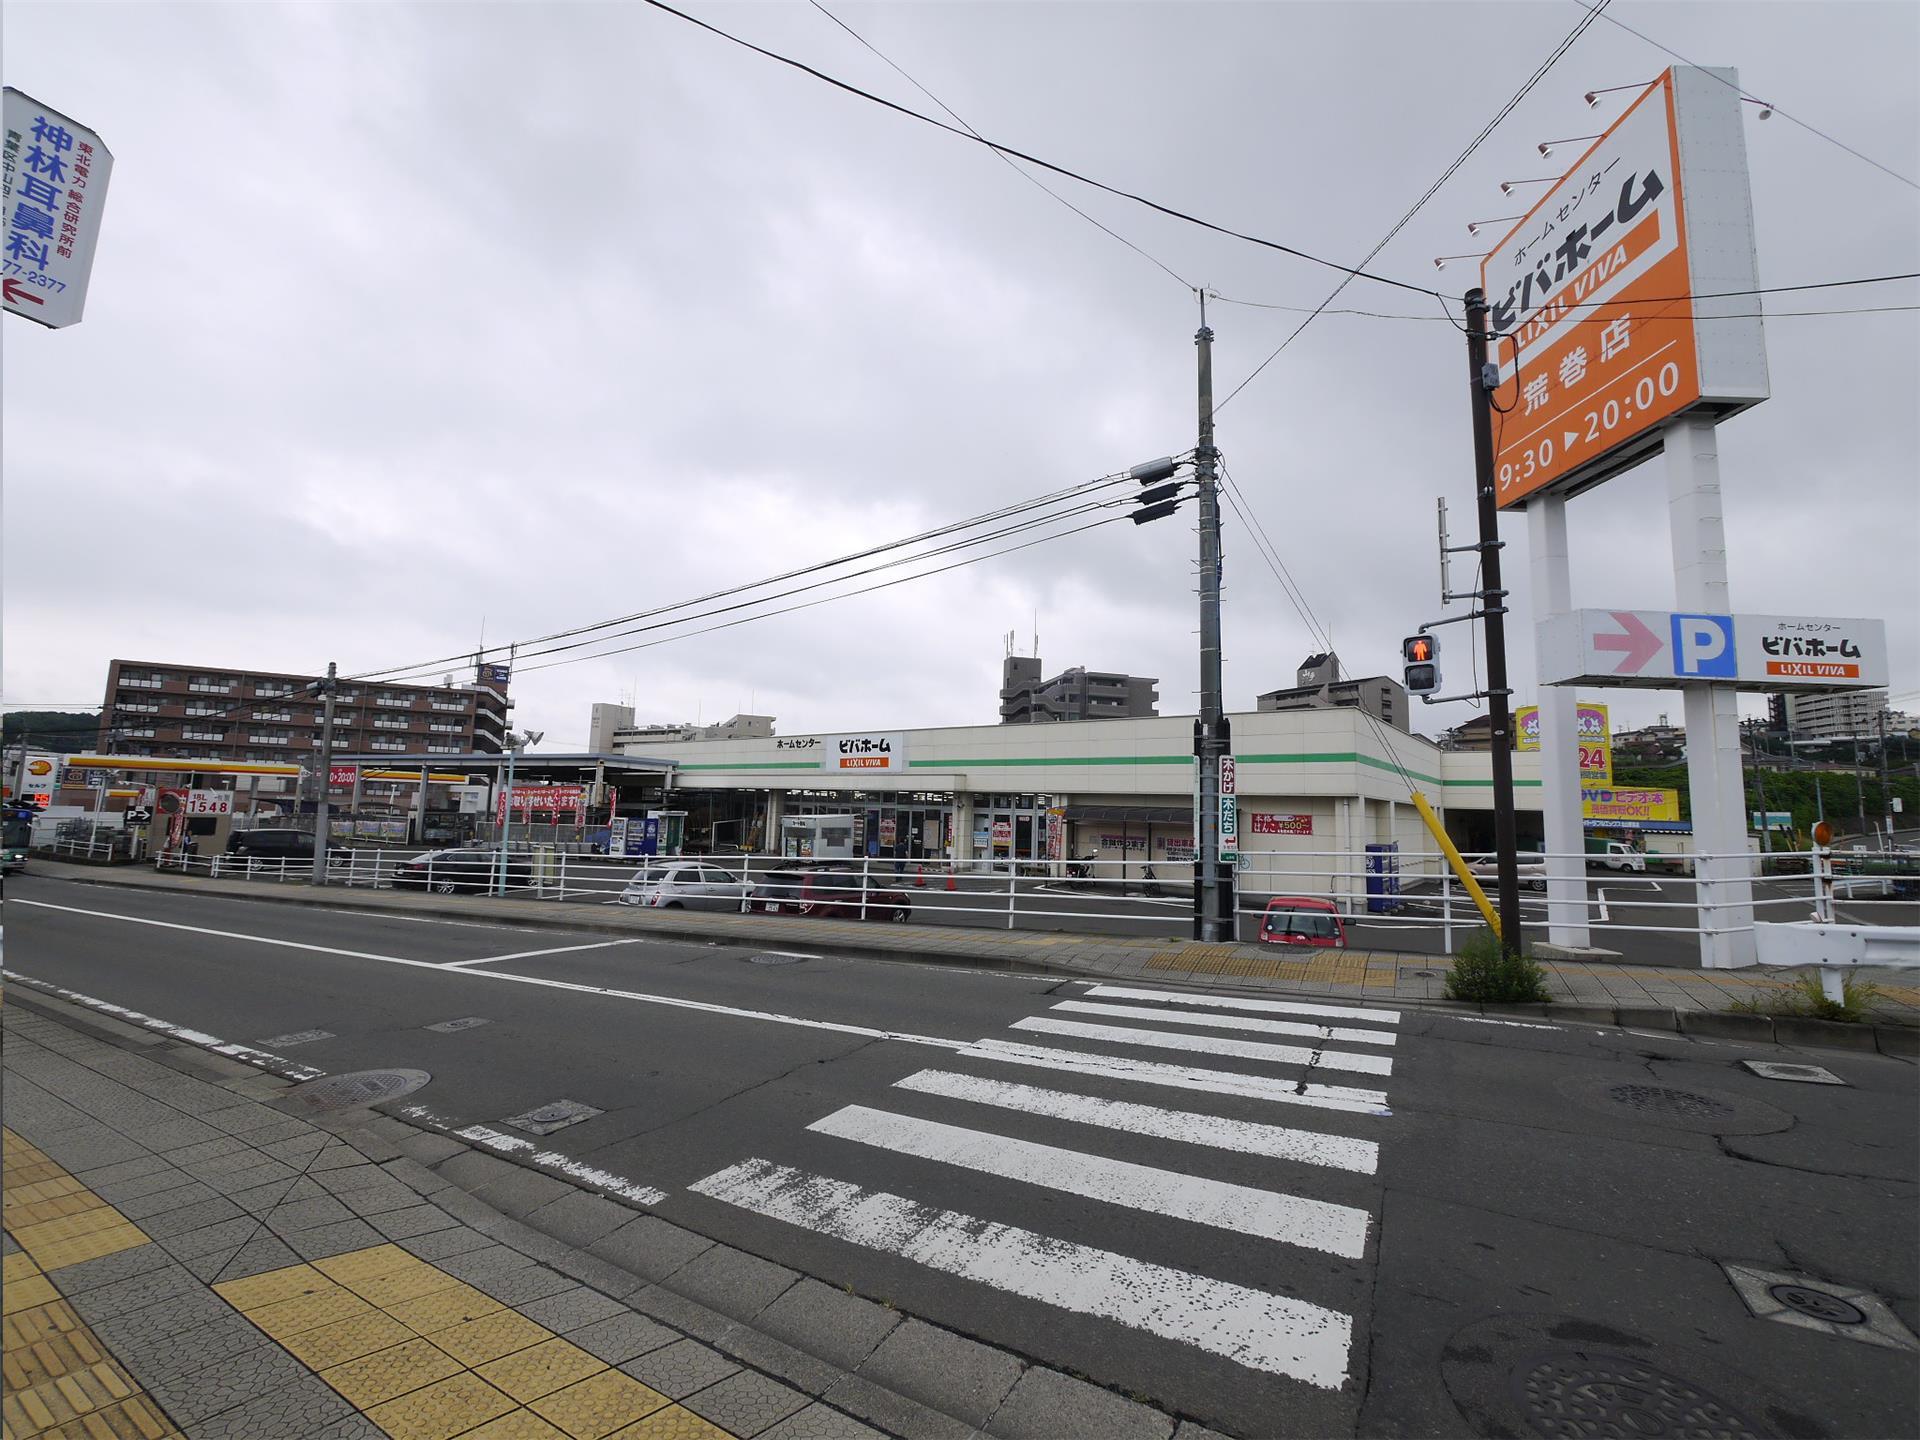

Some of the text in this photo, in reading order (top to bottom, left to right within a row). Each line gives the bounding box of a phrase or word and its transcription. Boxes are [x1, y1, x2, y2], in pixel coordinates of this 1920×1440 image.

[6, 115, 74, 272] 神林耳鼻科
[1514, 157, 1621, 267] ホームセンター
[1491, 169, 1665, 332] ビバホーム
[1515, 244, 1628, 349] LIXIL VIVA
[1522, 312, 1632, 417] 荒巻店
[1499, 361, 1680, 492] 9:30 20:00
[1777, 623, 1841, 632] ホームセンター
[1680, 618, 1726, 674] P
[1761, 636, 1862, 659] ビバホーム
[1780, 663, 1846, 676] LIXIL VIVA
[776, 738, 822, 749] ホームセンター
[839, 738, 891, 754] ビバホーム
[846, 758, 881, 767] LIXIL VIVA
[1223, 760, 1234, 793] 木かげ
[189, 800, 228, 813] 1548
[1223, 798, 1234, 833] 木だち
[1254, 822, 1276, 832] はんこ
